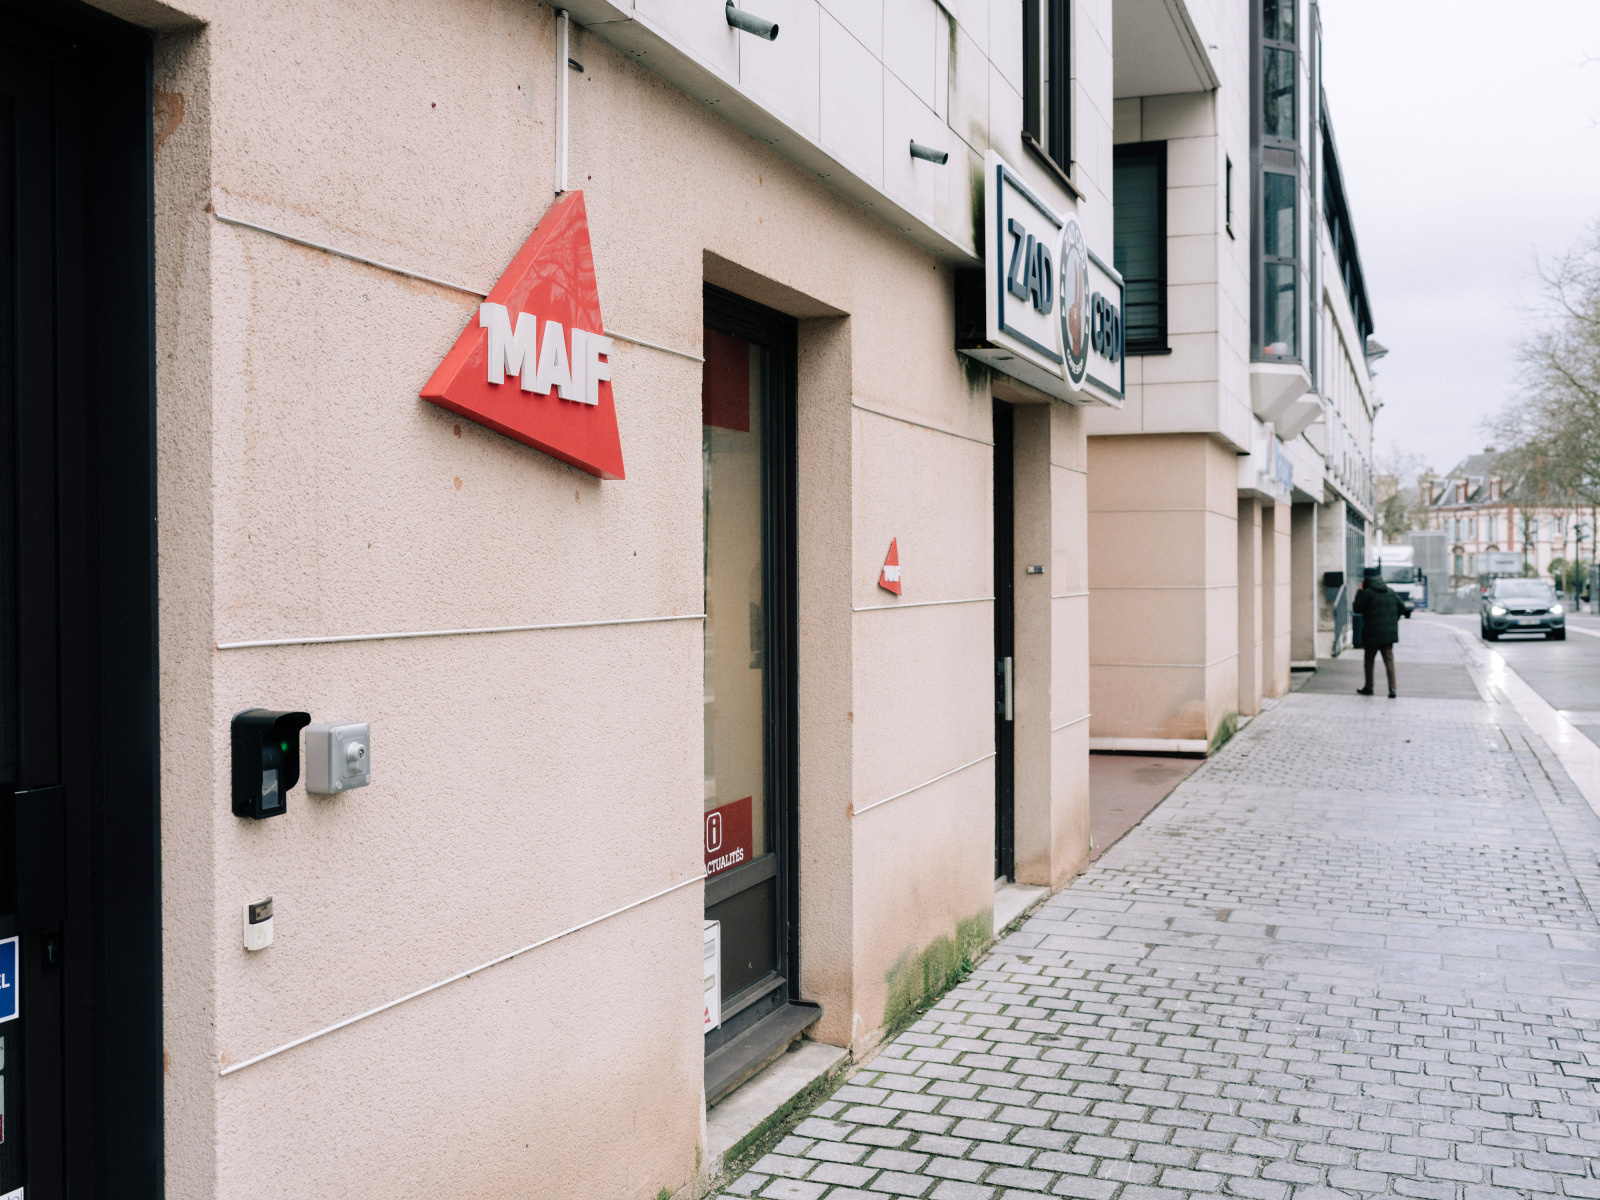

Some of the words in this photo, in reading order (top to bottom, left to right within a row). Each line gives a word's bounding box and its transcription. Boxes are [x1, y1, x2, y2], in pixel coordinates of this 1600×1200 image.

[1008, 217, 1054, 315] ZAD
[1091, 291, 1120, 362] CBD
[479, 302, 614, 406] MAIF
